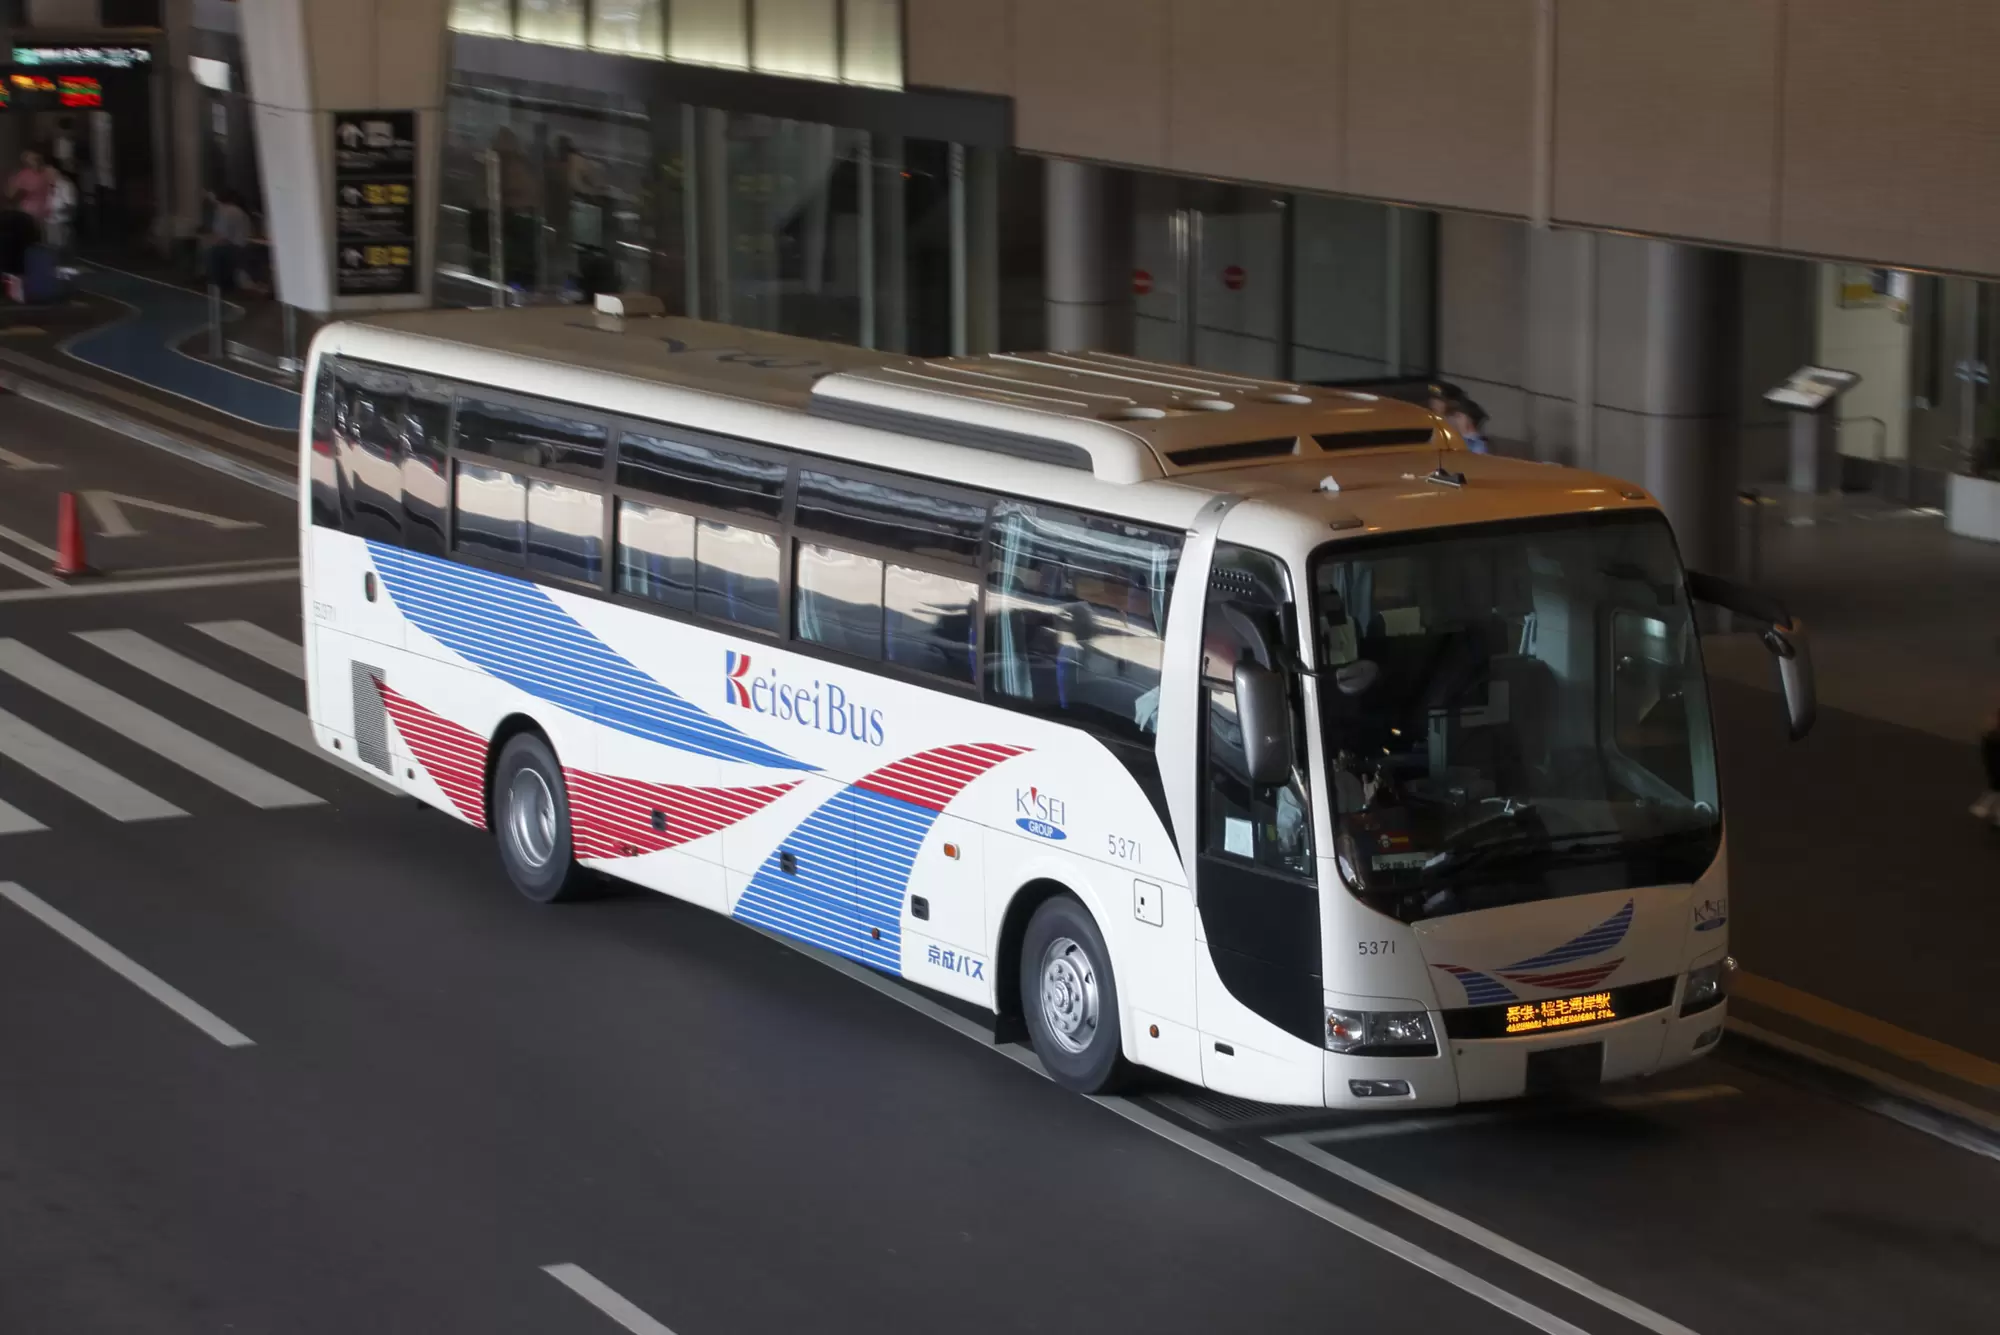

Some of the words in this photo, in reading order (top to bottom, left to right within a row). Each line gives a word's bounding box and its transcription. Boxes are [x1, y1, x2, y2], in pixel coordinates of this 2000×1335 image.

[1028, 820, 1054, 838] GROUP
[1108, 833, 1142, 864] 5371
[1358, 940, 1396, 956] 5371
[927, 944, 985, 981] 京成バス
